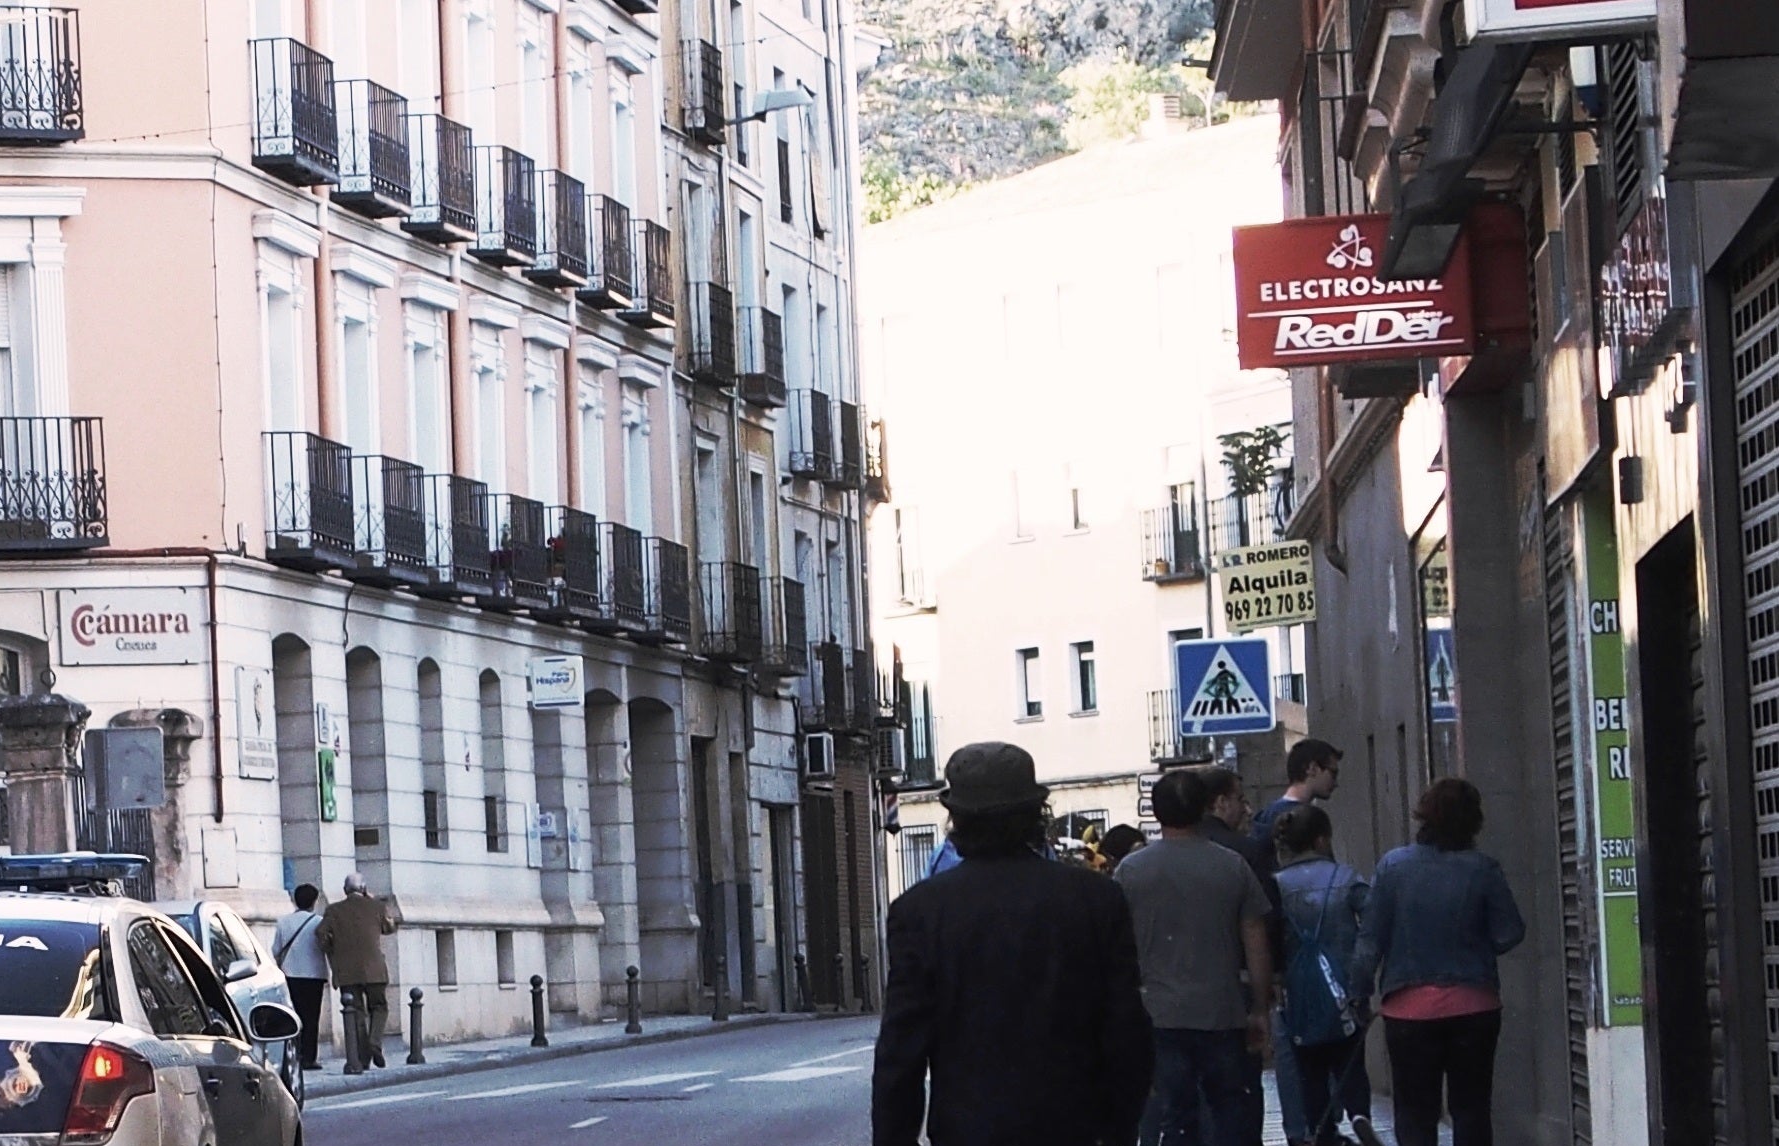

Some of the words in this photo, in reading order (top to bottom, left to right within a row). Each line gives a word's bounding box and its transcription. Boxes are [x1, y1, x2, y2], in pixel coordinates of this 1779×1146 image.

[1260, 276, 1443, 302] ELECTROSANZ
[1275, 310, 1454, 349] RedDer
[1246, 544, 1309, 564] ROMERO
[1228, 569, 1308, 595] Alquila
[1225, 599, 1250, 621] 969
[1255, 596, 1272, 617] 22
[1276, 593, 1294, 614] 70
[1298, 590, 1314, 611] 85
